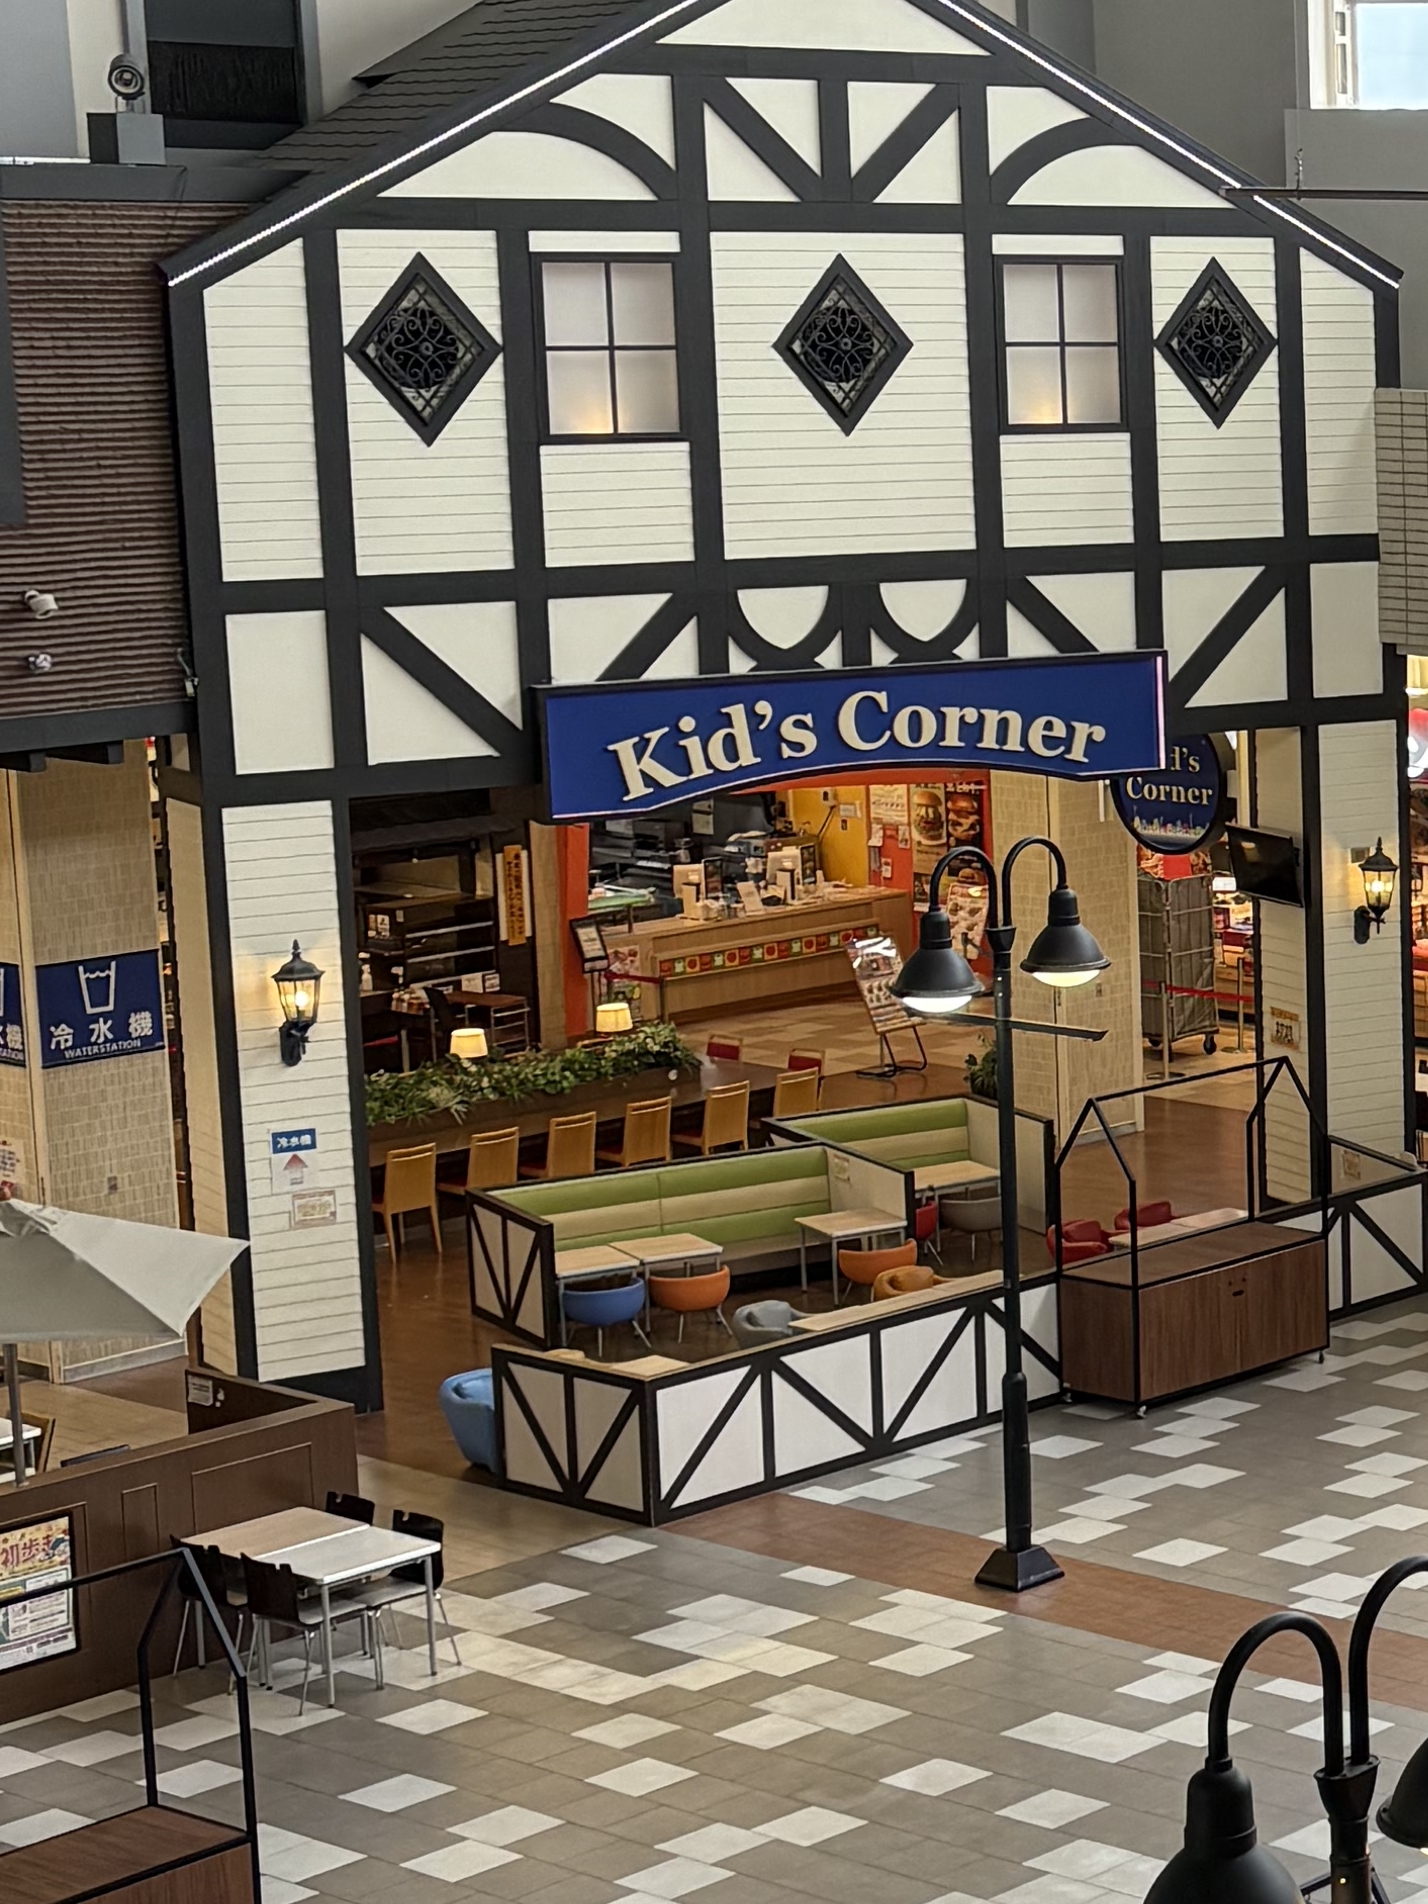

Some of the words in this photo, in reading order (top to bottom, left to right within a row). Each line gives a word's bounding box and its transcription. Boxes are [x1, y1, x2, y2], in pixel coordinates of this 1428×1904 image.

[608, 700, 818, 802] Kid's
[838, 691, 1107, 763] Corner
[1126, 776, 1213, 807] Corner
[49, 1010, 153, 1051] 冷水機
